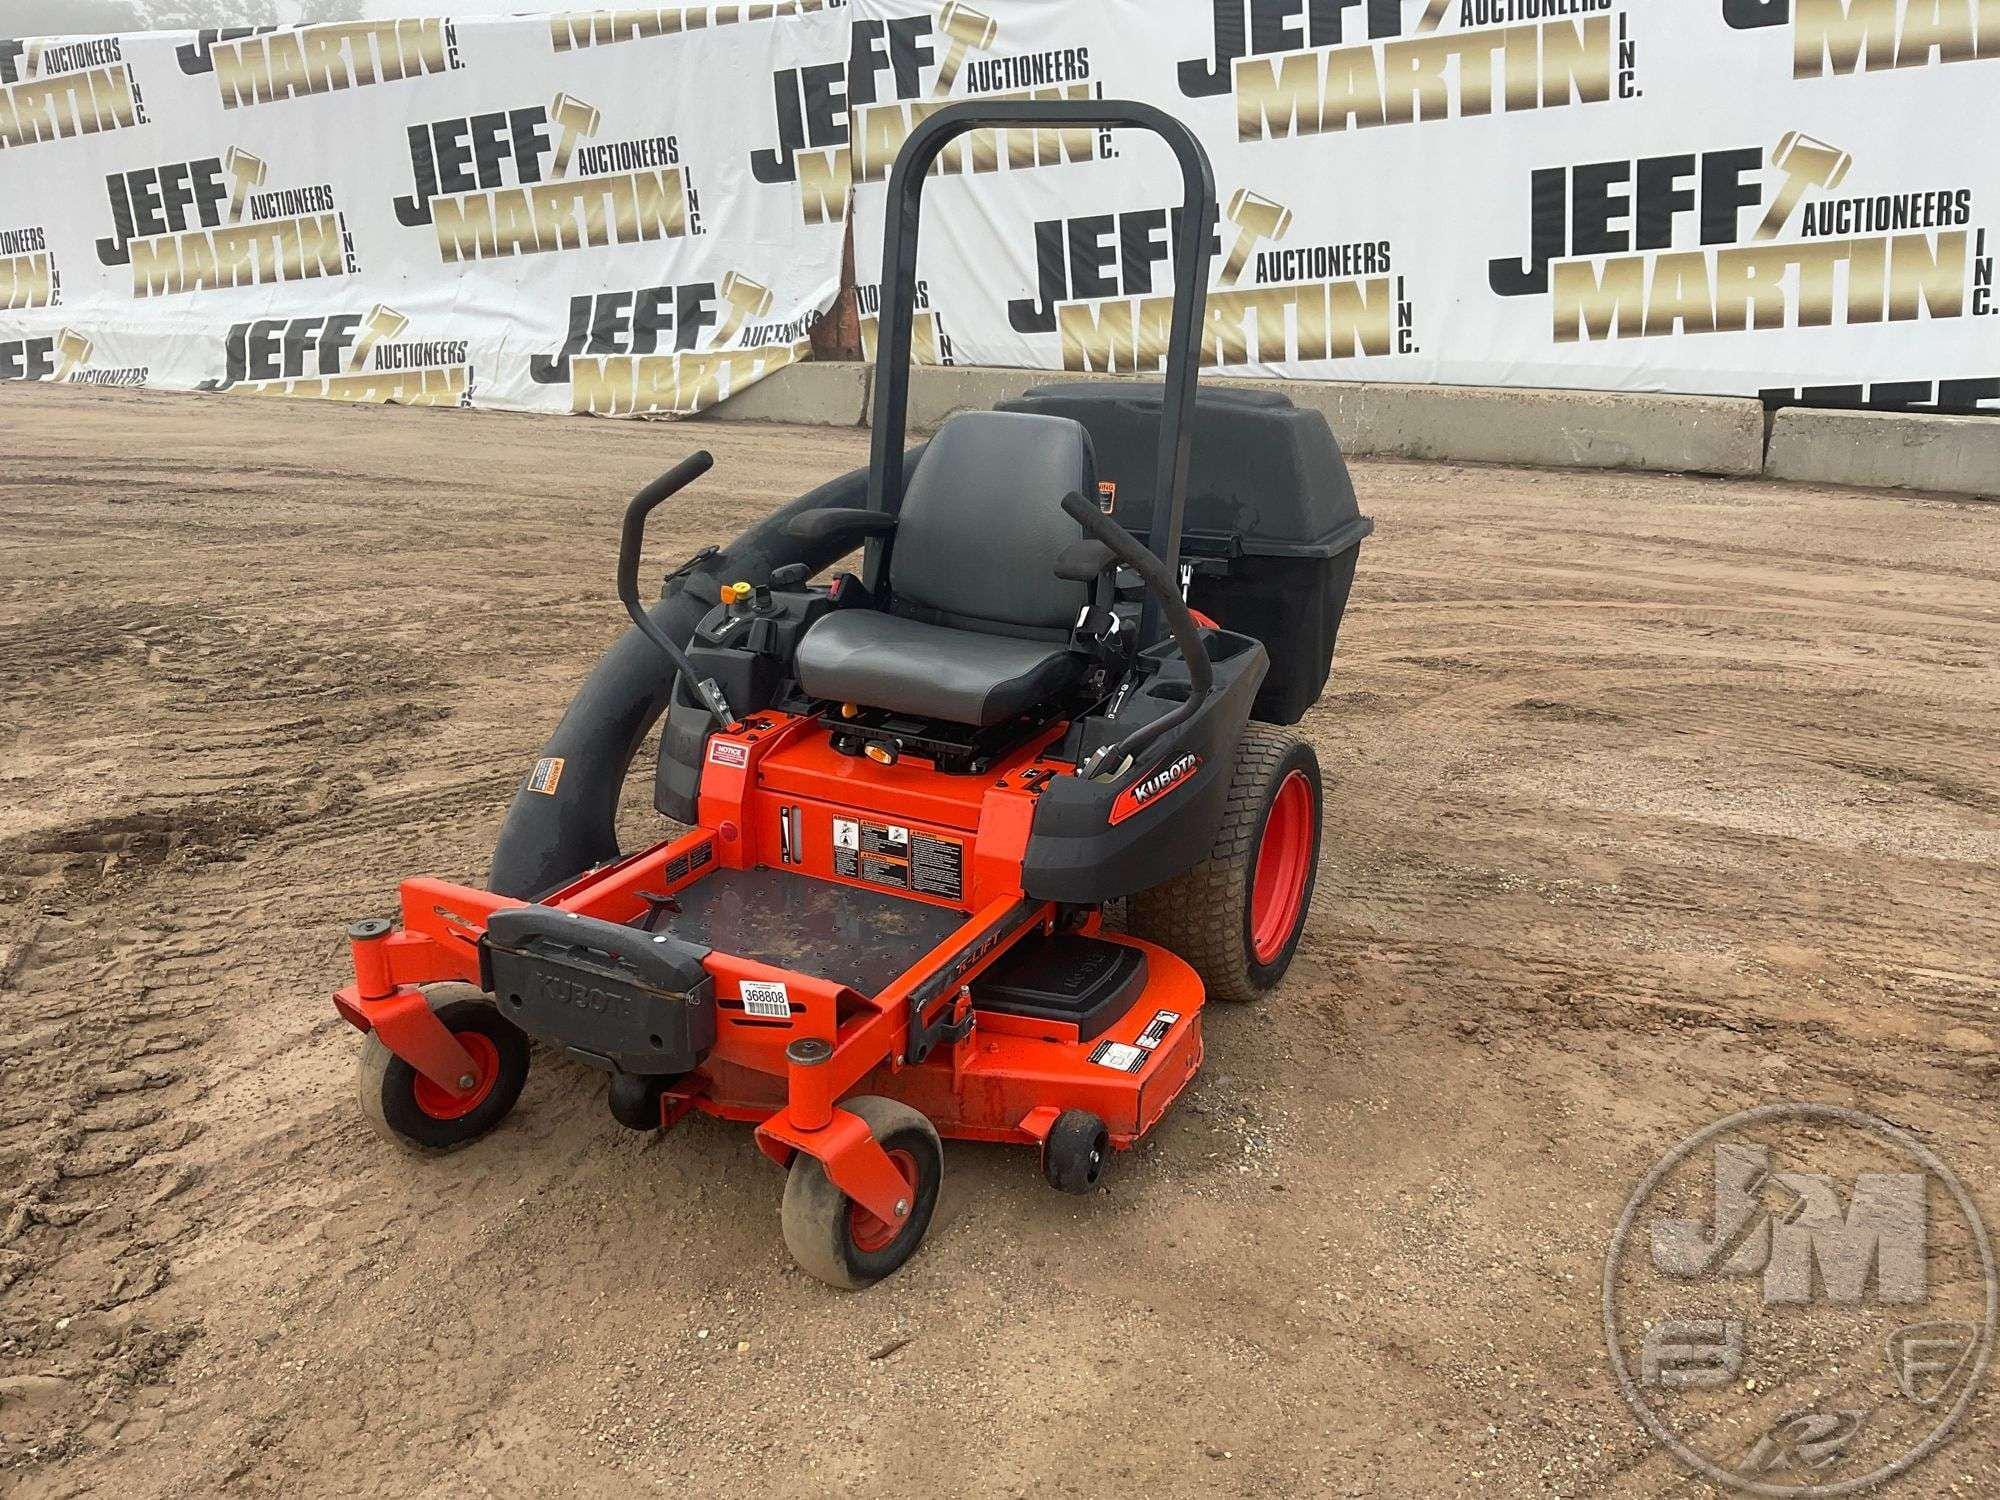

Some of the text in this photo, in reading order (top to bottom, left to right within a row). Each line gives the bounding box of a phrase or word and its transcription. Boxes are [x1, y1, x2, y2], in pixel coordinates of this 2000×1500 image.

[44, 37, 122, 75] AUCTIONEERS
[212, 18, 446, 110] MARTIN
[966, 47, 1090, 93] AUCTIONEERS
[1235, 15, 1611, 143] MARTIN
[1618, 11, 1643, 99] INC.
[127, 63, 152, 125] INC.
[393, 105, 551, 228] JEFF
[577, 136, 679, 176] AUCTIONEERS
[95, 158, 227, 267] JEFF
[249, 185, 334, 221] AUCTIONEERS
[432, 168, 687, 264] MARTIN
[684, 166, 707, 236] INC.
[1489, 147, 1763, 297] JEFF
[1801, 189, 1971, 238] AUCTIONEERS
[50, 252, 63, 306] INC.
[130, 213, 343, 299] MARTIN
[337, 212, 362, 273] INC.
[1256, 240, 1391, 284] AUCTIONEERS
[1972, 228, 2000, 316] INC.
[1397, 275, 1420, 354] INC.
[1552, 230, 1968, 343] MARTIN
[194, 314, 364, 391] JEFF
[375, 341, 469, 371] AUCTIONEERS
[529, 282, 717, 384] JEFF
[1134, 753, 1196, 803] KUBOTA
[745, 989, 785, 1004] 368808
